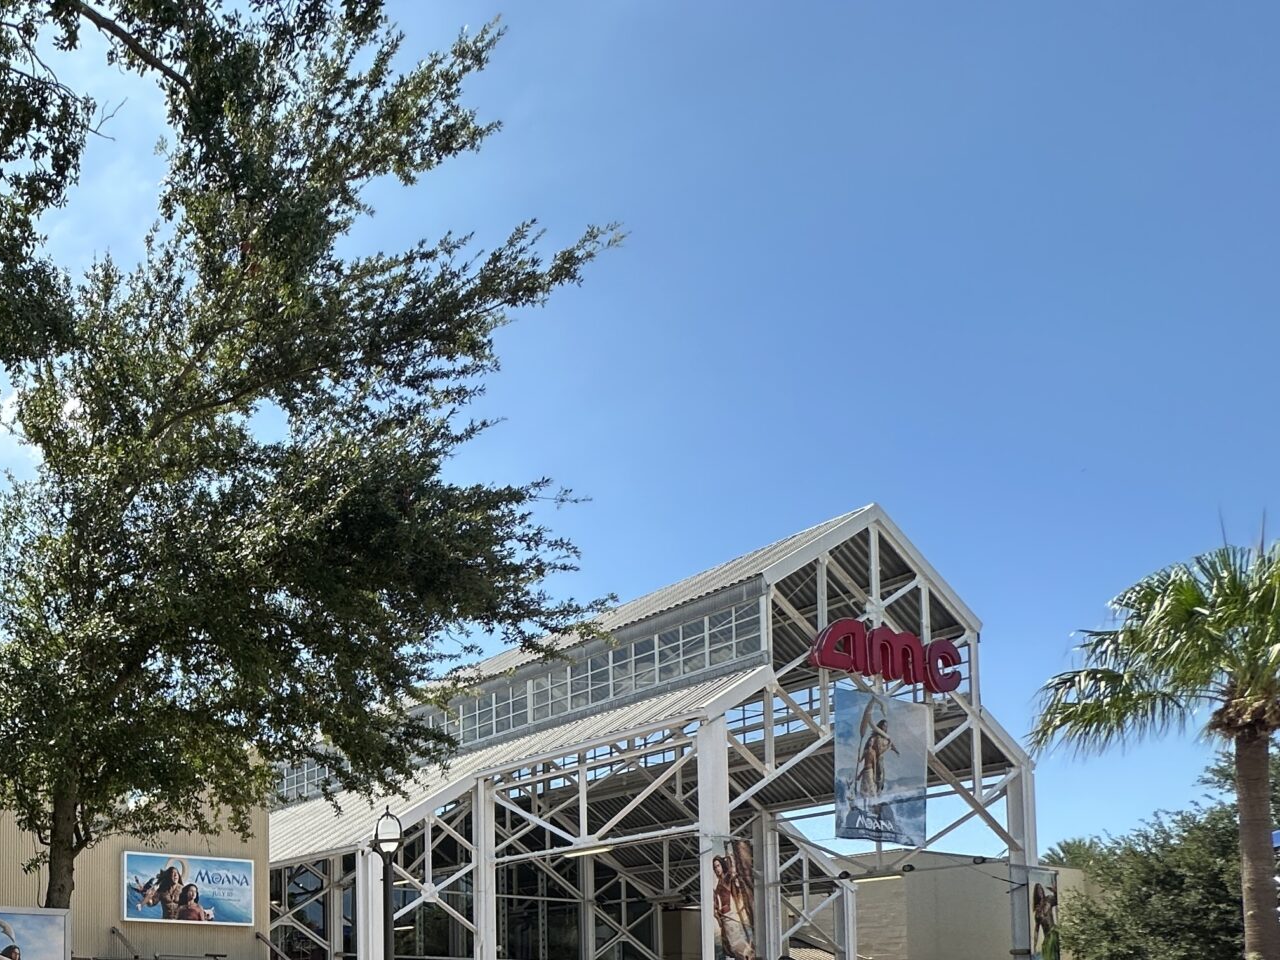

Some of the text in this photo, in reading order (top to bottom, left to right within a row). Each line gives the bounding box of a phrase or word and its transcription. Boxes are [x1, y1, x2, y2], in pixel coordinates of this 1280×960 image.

[810, 617, 961, 694] amc
[856, 815, 895, 831] MOANA
[195, 869, 249, 887] MOANA
